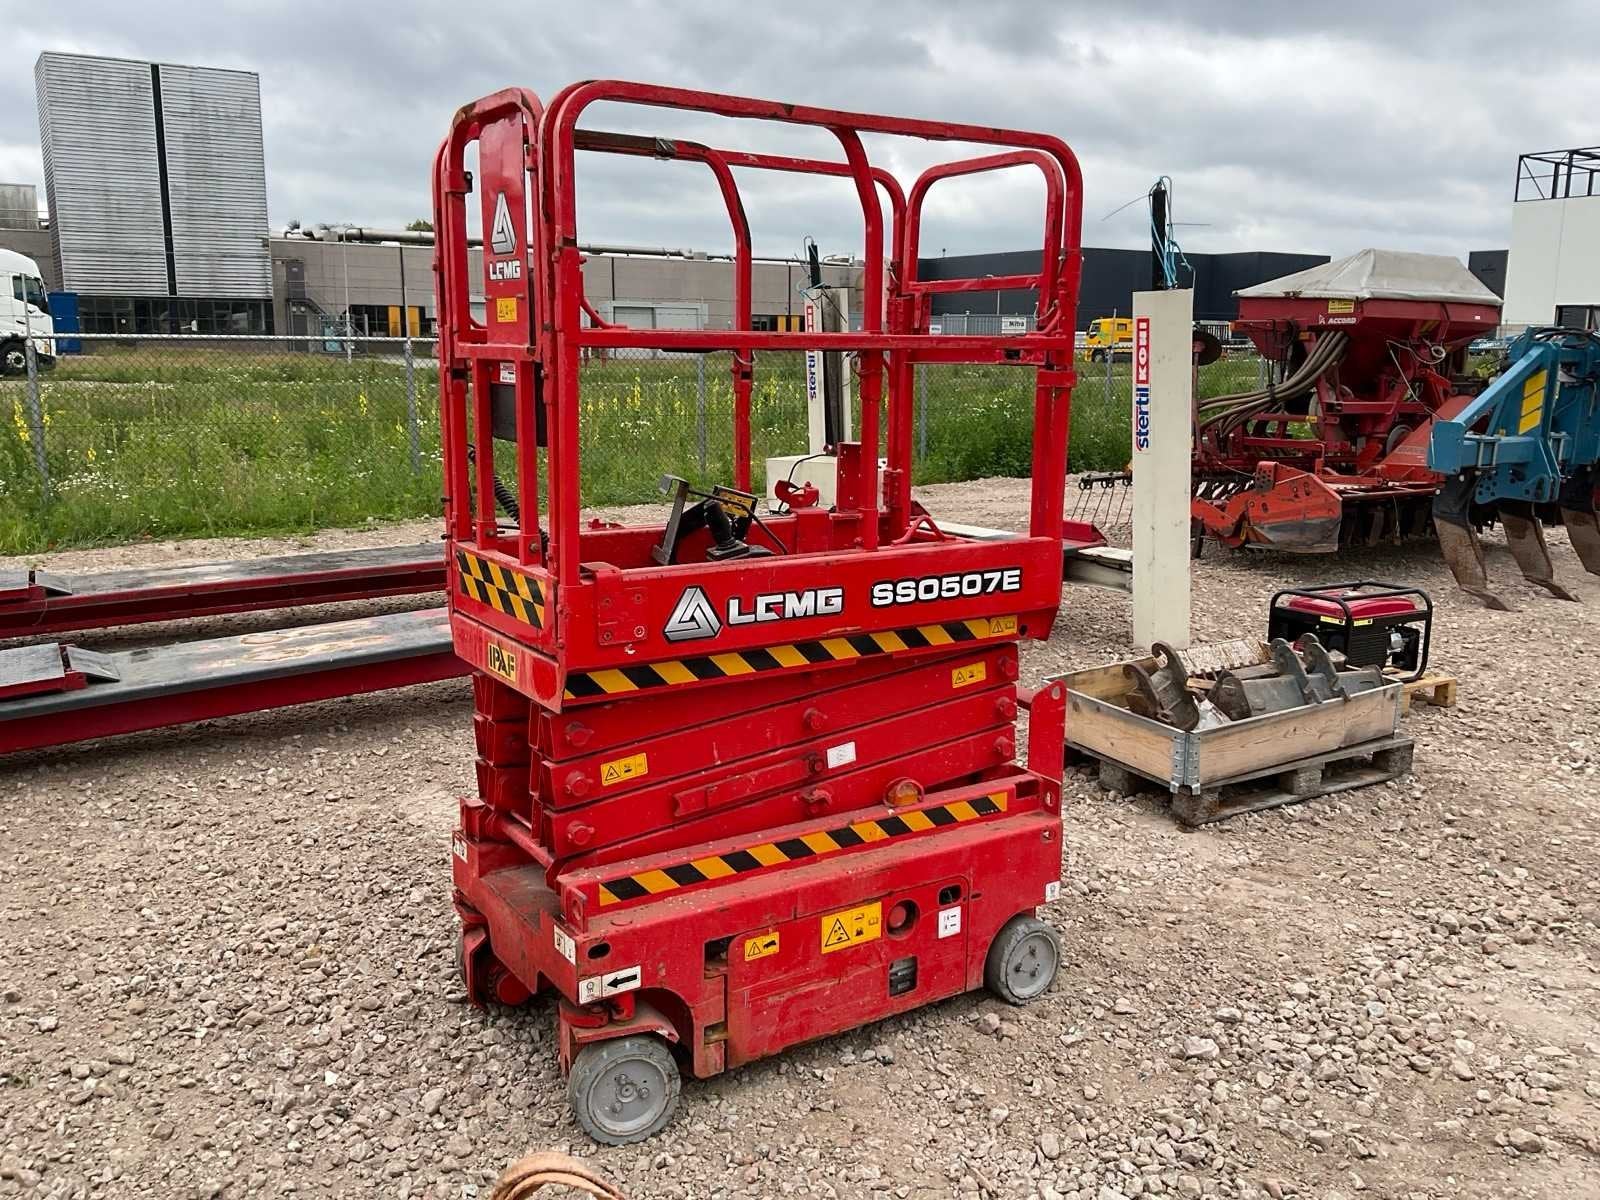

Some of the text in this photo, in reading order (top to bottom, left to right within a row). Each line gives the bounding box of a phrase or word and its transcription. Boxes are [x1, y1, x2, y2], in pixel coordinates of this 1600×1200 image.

[490, 260, 520, 280] LCMG
[1136, 320, 1150, 450] stertil KONI
[728, 569, 1021, 625] LCMG SS0507E
